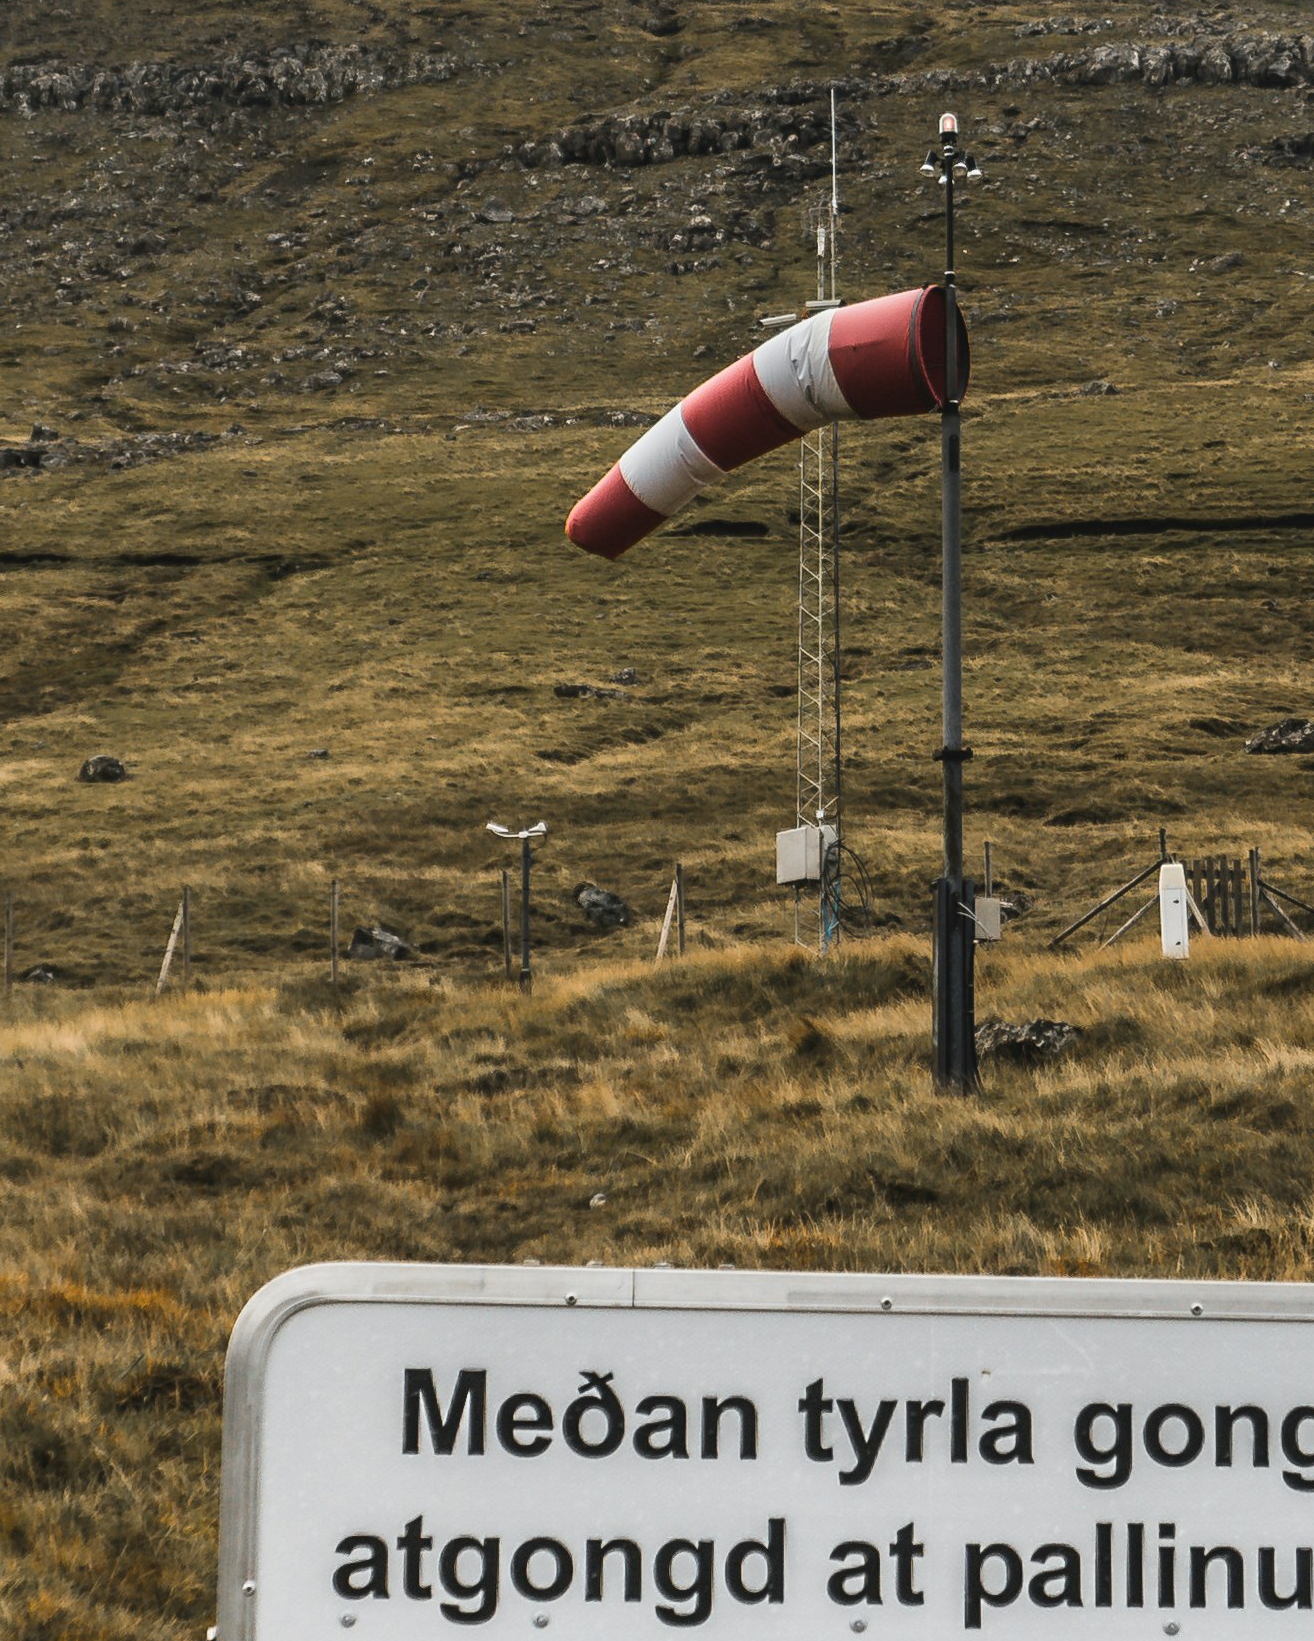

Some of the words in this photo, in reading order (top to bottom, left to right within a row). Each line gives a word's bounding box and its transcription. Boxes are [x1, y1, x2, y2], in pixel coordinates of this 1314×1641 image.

[401, 1367, 759, 1463] Meðan
[797, 1376, 1036, 1488] tyrla
[331, 1514, 787, 1628] atgongd
[826, 1521, 926, 1607] at
